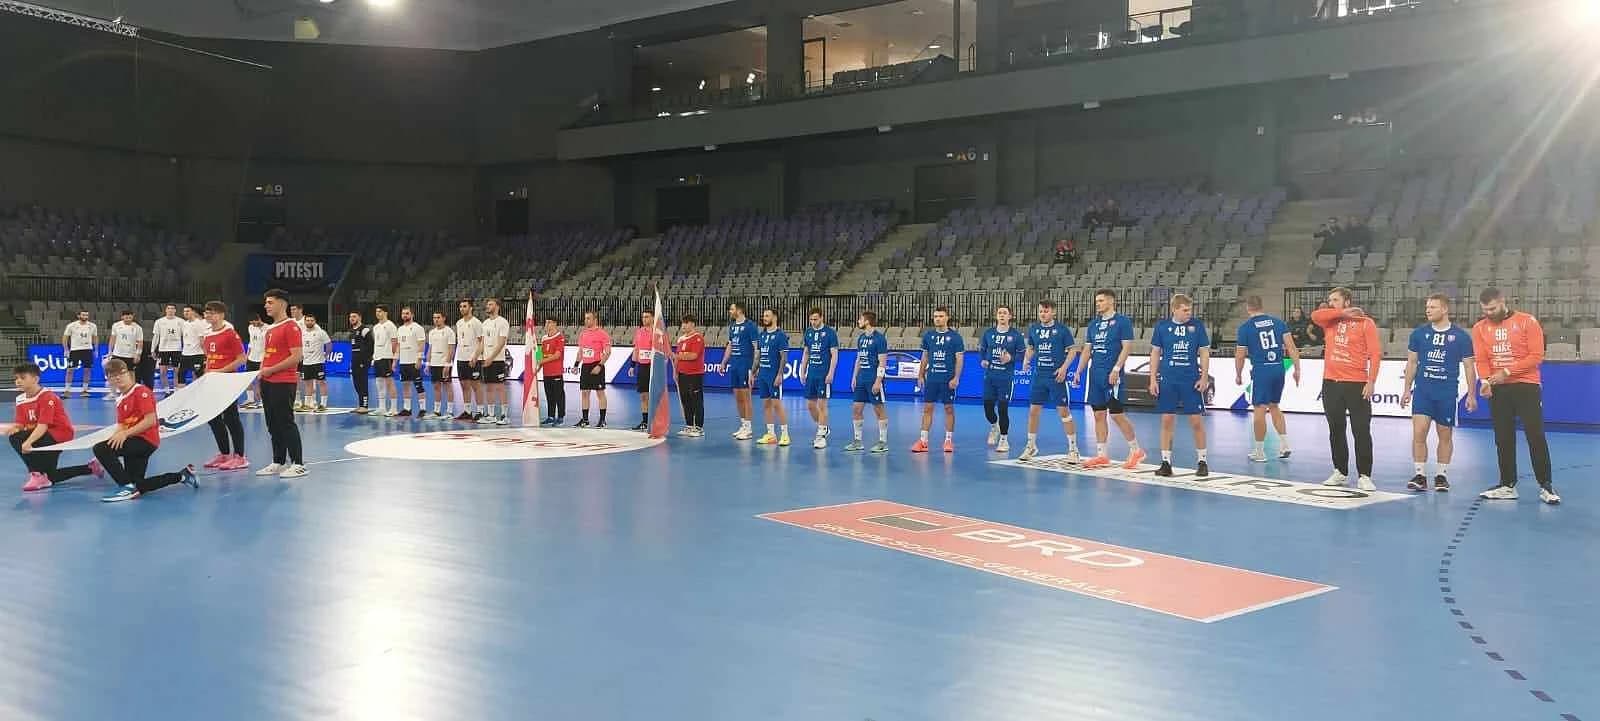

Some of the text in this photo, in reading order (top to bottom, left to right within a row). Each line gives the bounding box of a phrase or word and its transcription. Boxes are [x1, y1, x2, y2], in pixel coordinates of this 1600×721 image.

[264, 184, 283, 195] A9
[1039, 329, 1050, 339] 34
[1174, 325, 1186, 337] 43
[1495, 327, 1508, 341] 96
[935, 336, 945, 345] 14
[995, 335, 1006, 345] 27
[1259, 329, 1278, 350] 61
[1432, 333, 1446, 346] 81
[954, 529, 1145, 567] BRD
